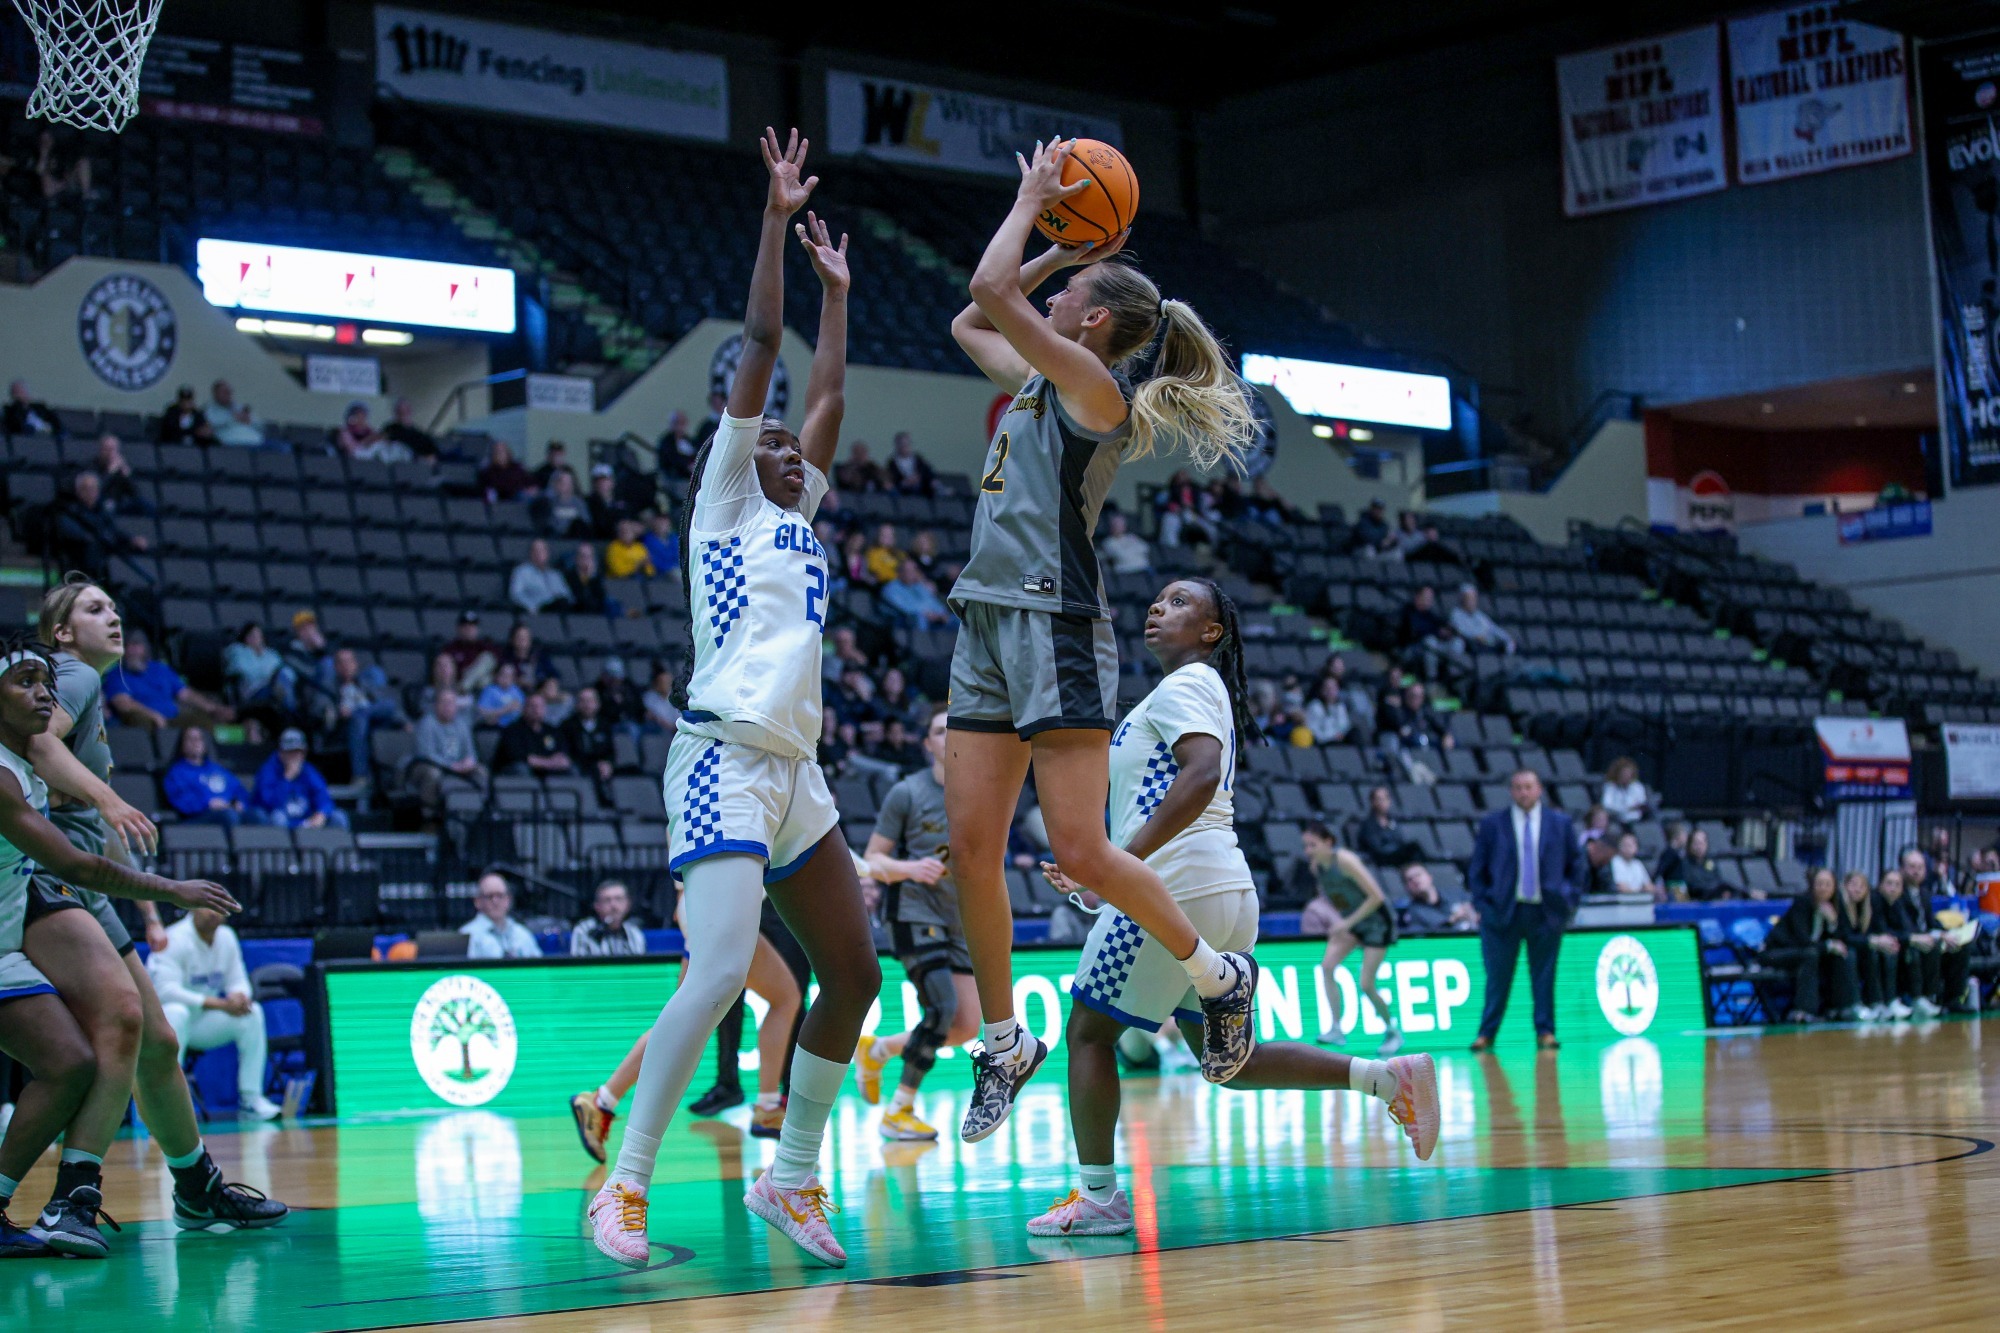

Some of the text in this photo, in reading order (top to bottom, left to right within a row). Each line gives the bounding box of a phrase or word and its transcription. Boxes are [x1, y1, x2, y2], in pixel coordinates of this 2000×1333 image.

[477, 47, 587, 96] Fencing
[981, 431, 1011, 494] 2
[1313, 959, 1472, 1036] DEEP
